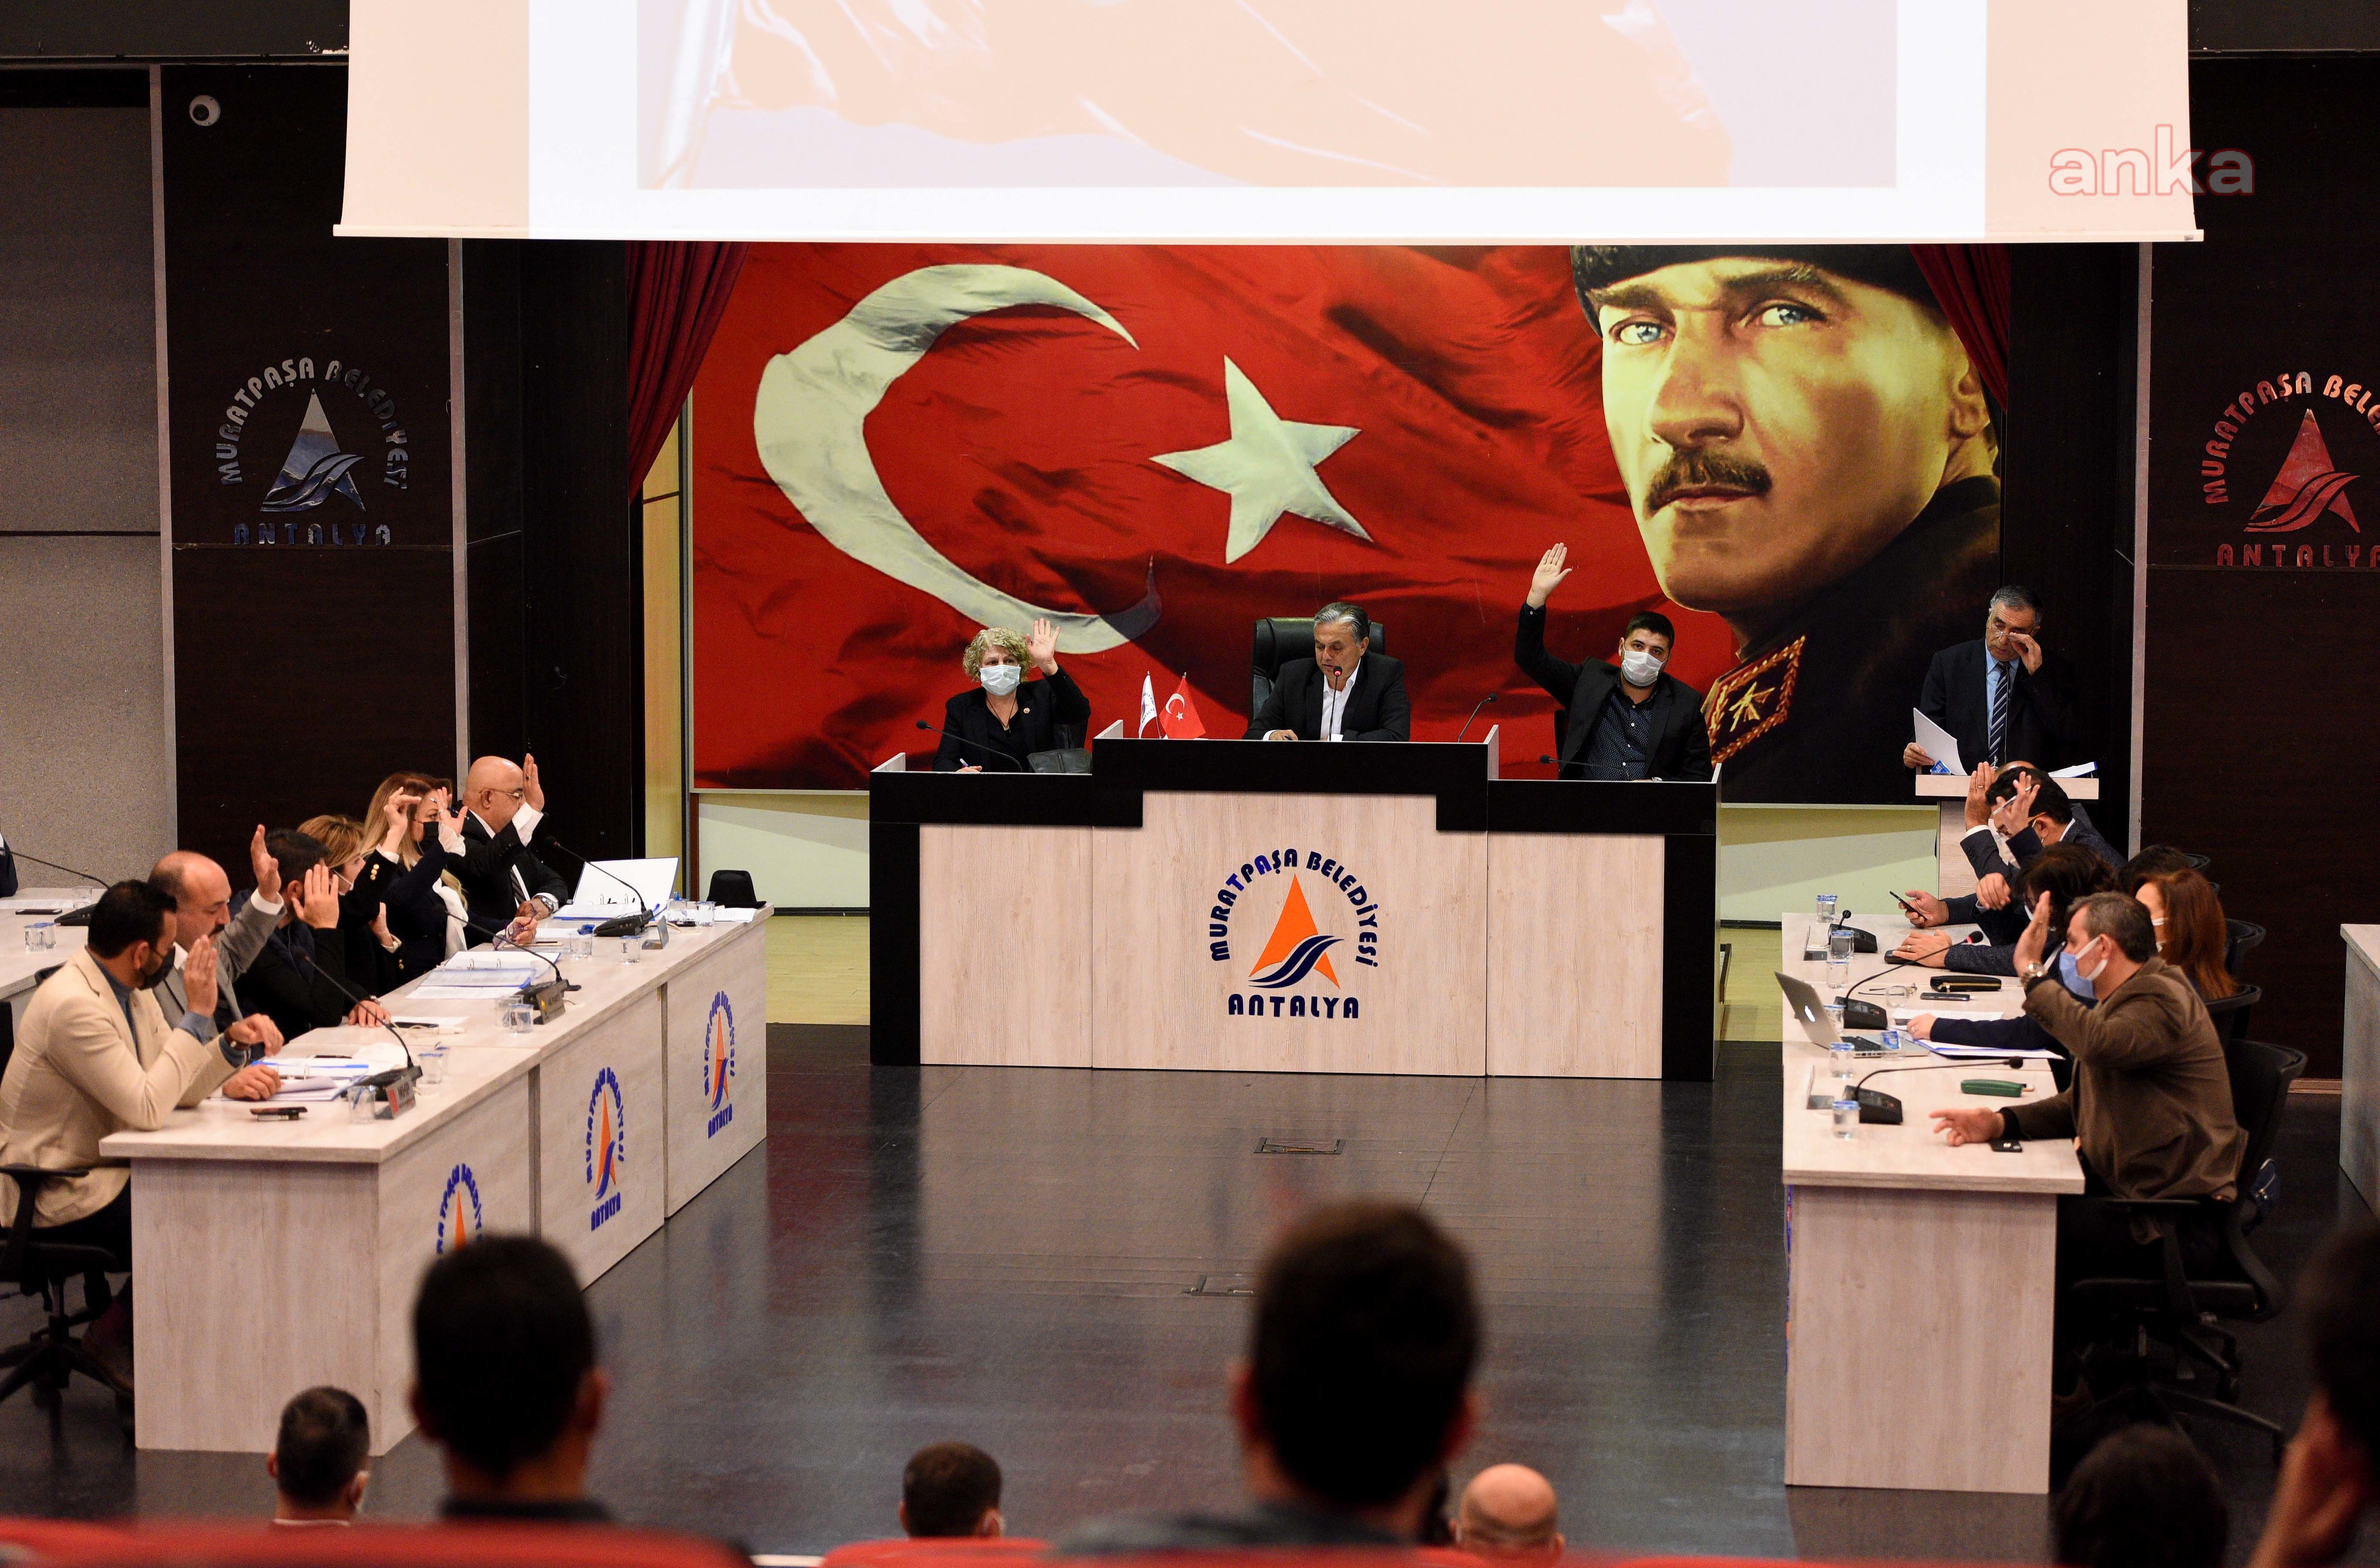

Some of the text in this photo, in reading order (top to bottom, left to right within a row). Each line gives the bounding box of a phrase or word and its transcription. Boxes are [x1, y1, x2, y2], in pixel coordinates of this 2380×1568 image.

[216, 357, 314, 485] MURATPAŞA
[2201, 371, 2312, 504] MURATPAŞA
[234, 523, 390, 546] ANTALYA
[1209, 848, 1379, 967] MURATPAŞA BELEDİYESİ
[1228, 994, 1359, 1019] ANTALYA
